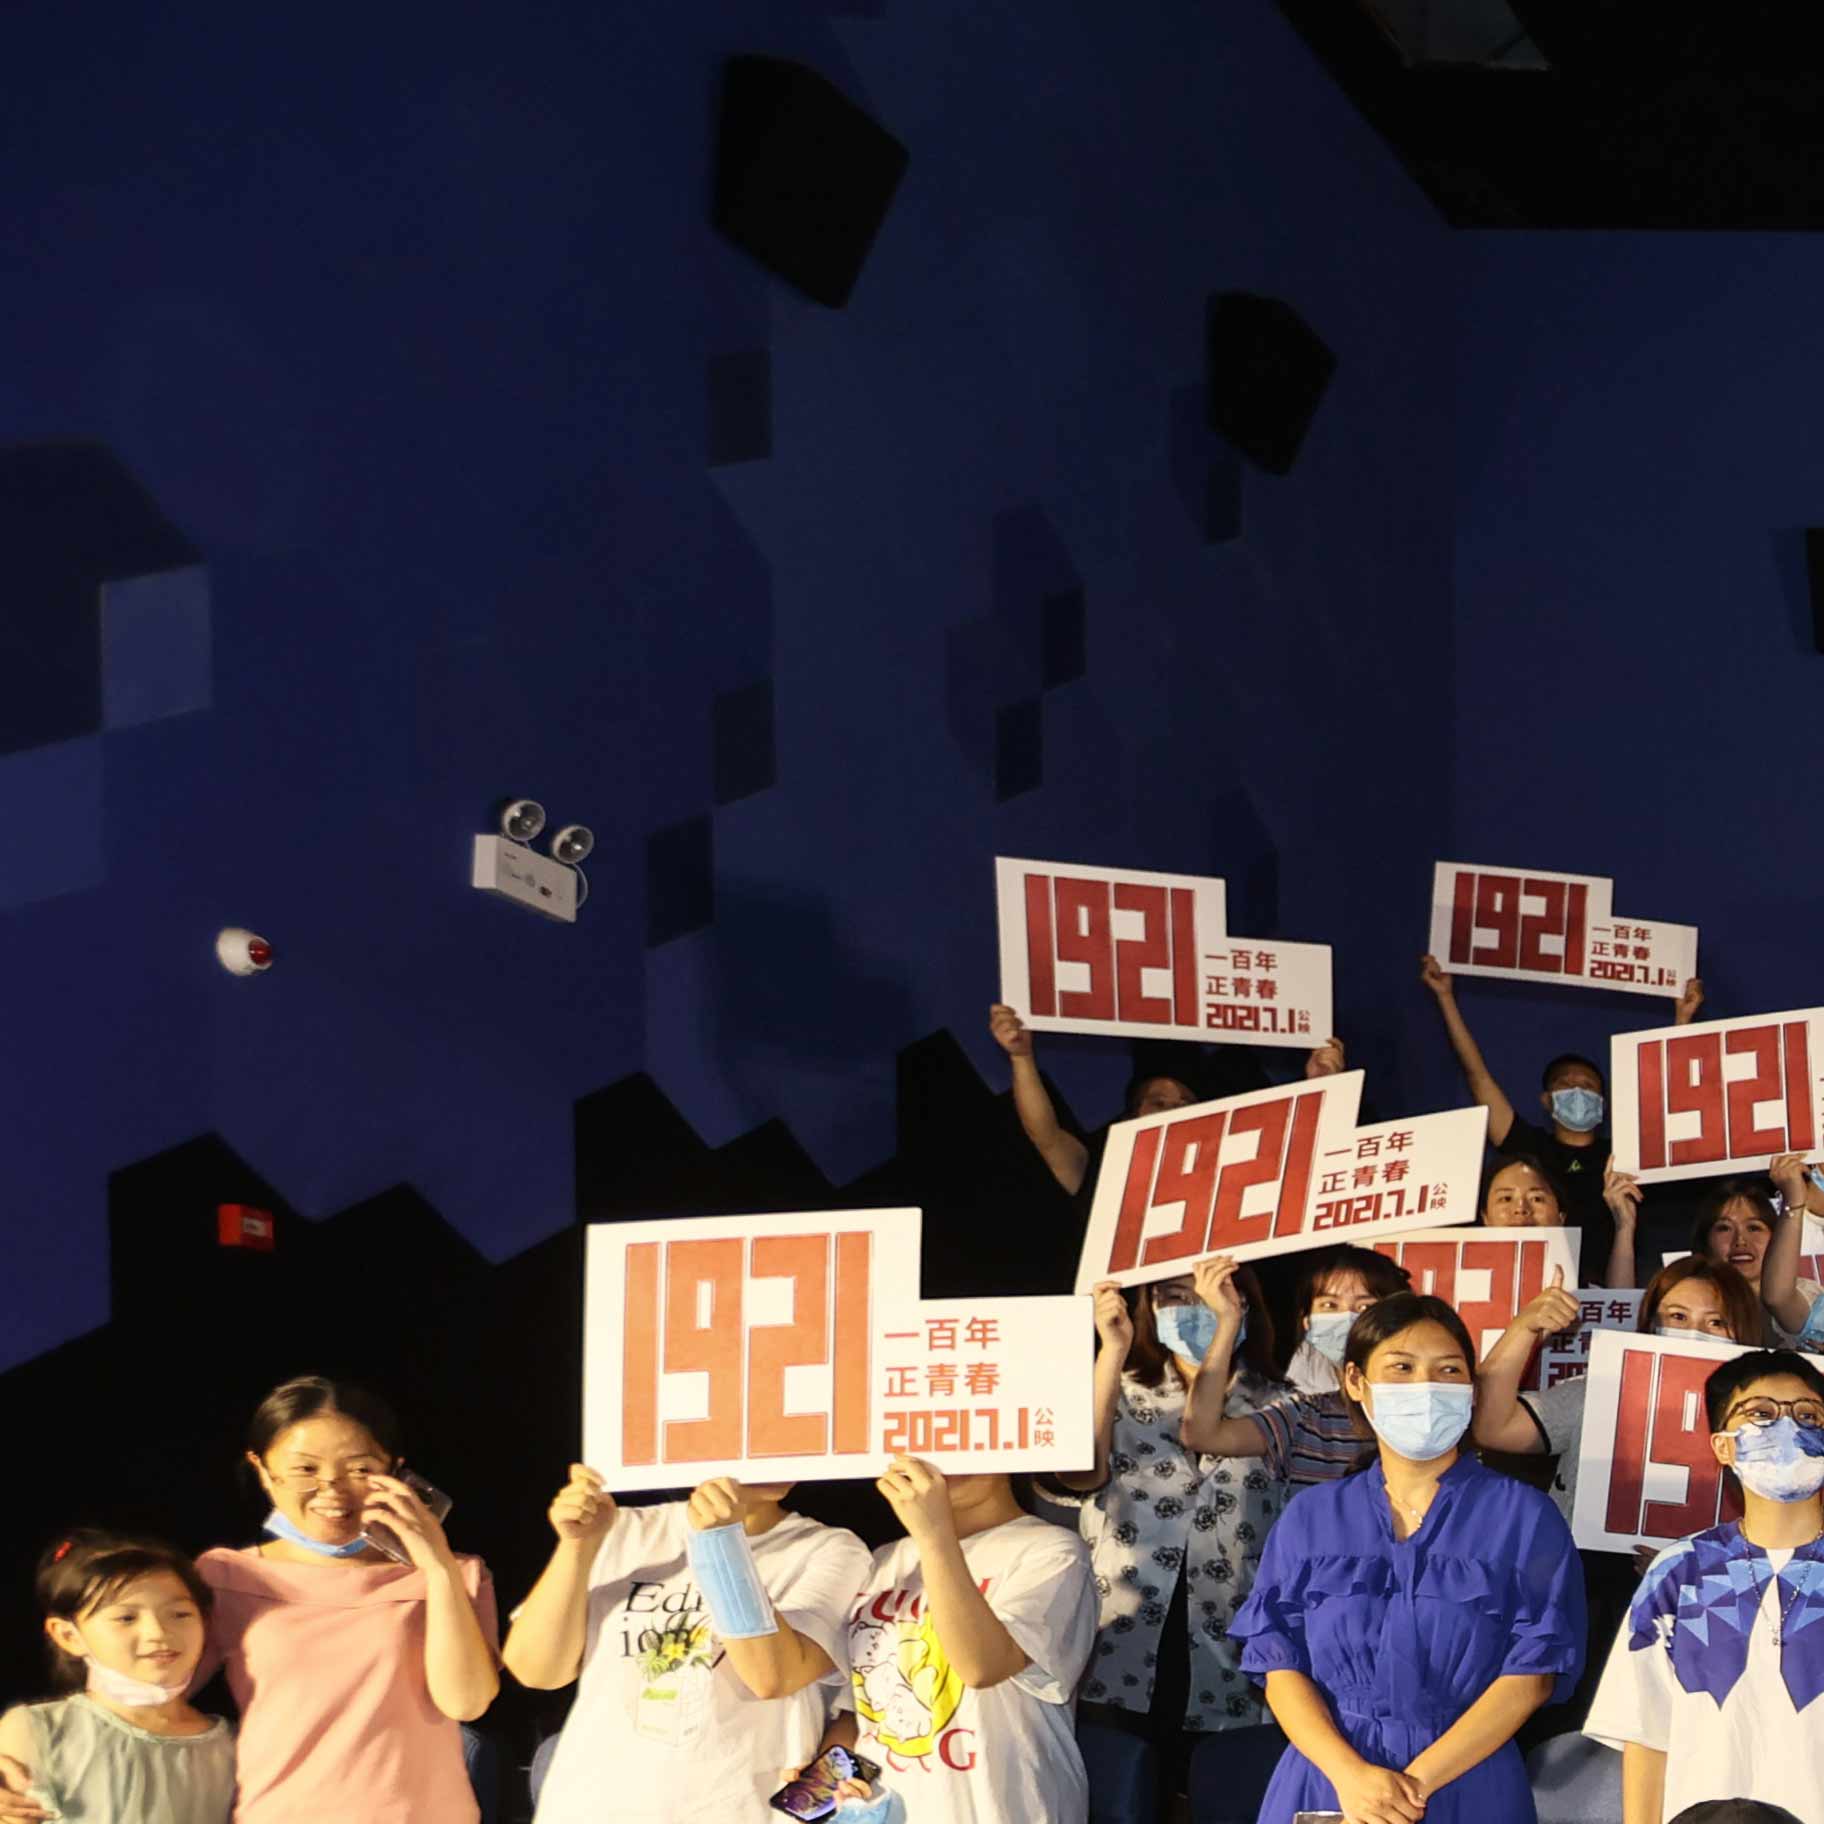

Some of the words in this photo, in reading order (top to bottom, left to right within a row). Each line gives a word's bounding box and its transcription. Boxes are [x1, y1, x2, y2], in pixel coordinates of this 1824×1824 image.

[1449, 872, 1589, 976] 1921
[1592, 926, 1651, 940] 一百年
[1024, 873, 1198, 1027] 1921
[1205, 950, 1278, 971] 一百年
[1592, 941, 1650, 961] 正青春
[1206, 976, 1278, 1000] 正青春
[1590, 960, 1664, 986] 2021.7.1
[1206, 1003, 1295, 1034] 2021.7.1
[1638, 1021, 1815, 1170] 1921
[1324, 1131, 1414, 1160] 一百年
[1108, 1090, 1326, 1274] 1921
[1318, 1160, 1410, 1194] 正青春
[1313, 1185, 1429, 1231] 2021.7.1
[621, 1230, 873, 1466] 1921
[884, 1316, 1000, 1351] 一百年
[884, 1362, 1000, 1398] 正青春
[883, 1407, 1028, 1454] 2021.7.1
